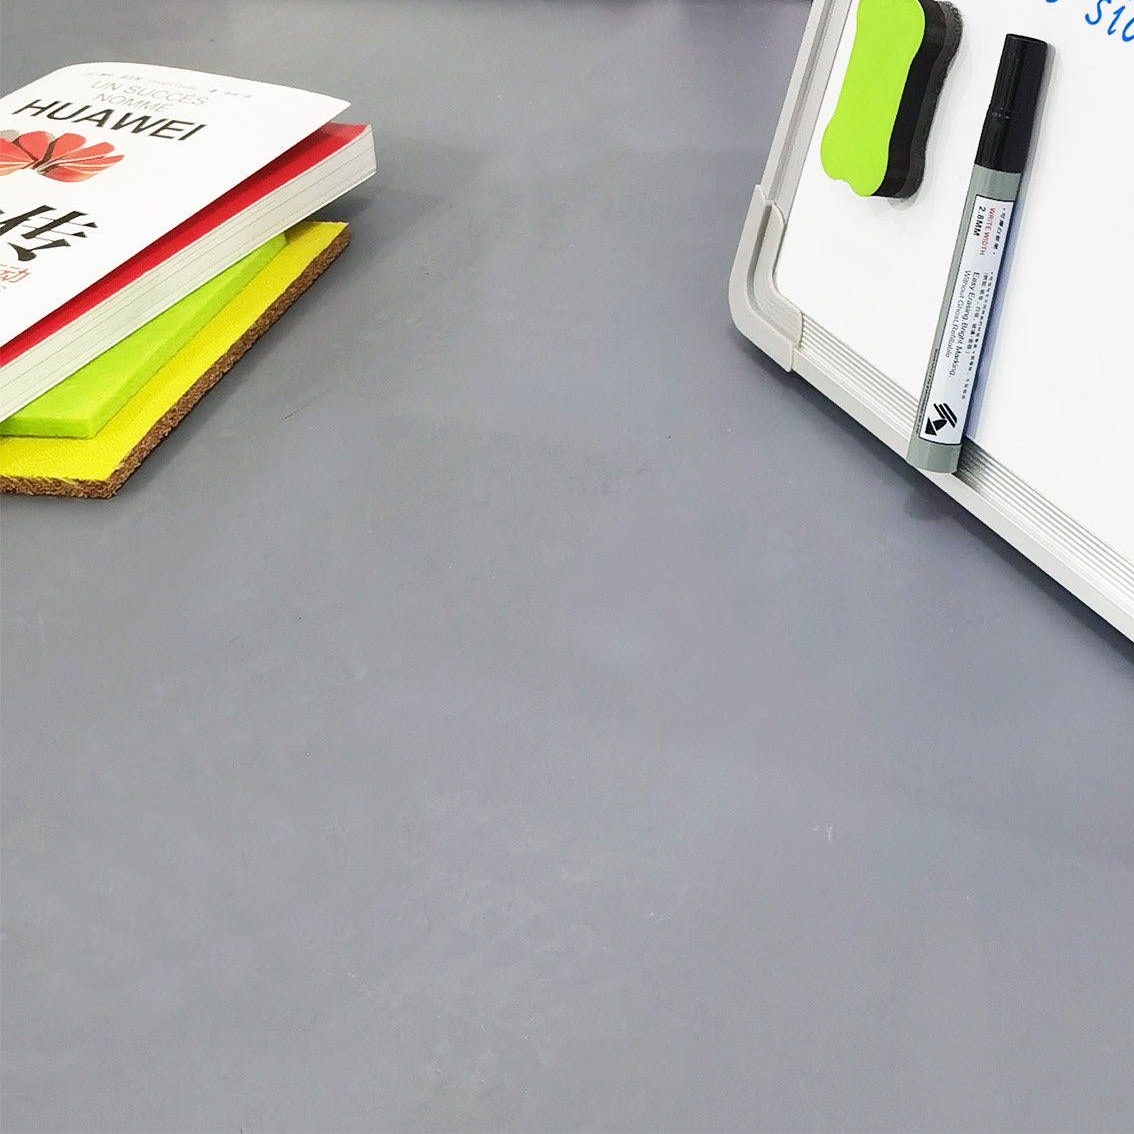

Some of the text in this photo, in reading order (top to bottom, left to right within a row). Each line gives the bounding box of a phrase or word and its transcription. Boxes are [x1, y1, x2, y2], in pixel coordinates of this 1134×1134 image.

[90, 80, 122, 92] UN
[11, 98, 208, 141] HUAWEI
[973, 206, 986, 236] 2.8MM
[979, 207, 995, 255] WRITE WIDTH
[958, 269, 971, 298] Without
[968, 271, 980, 291] Easy
